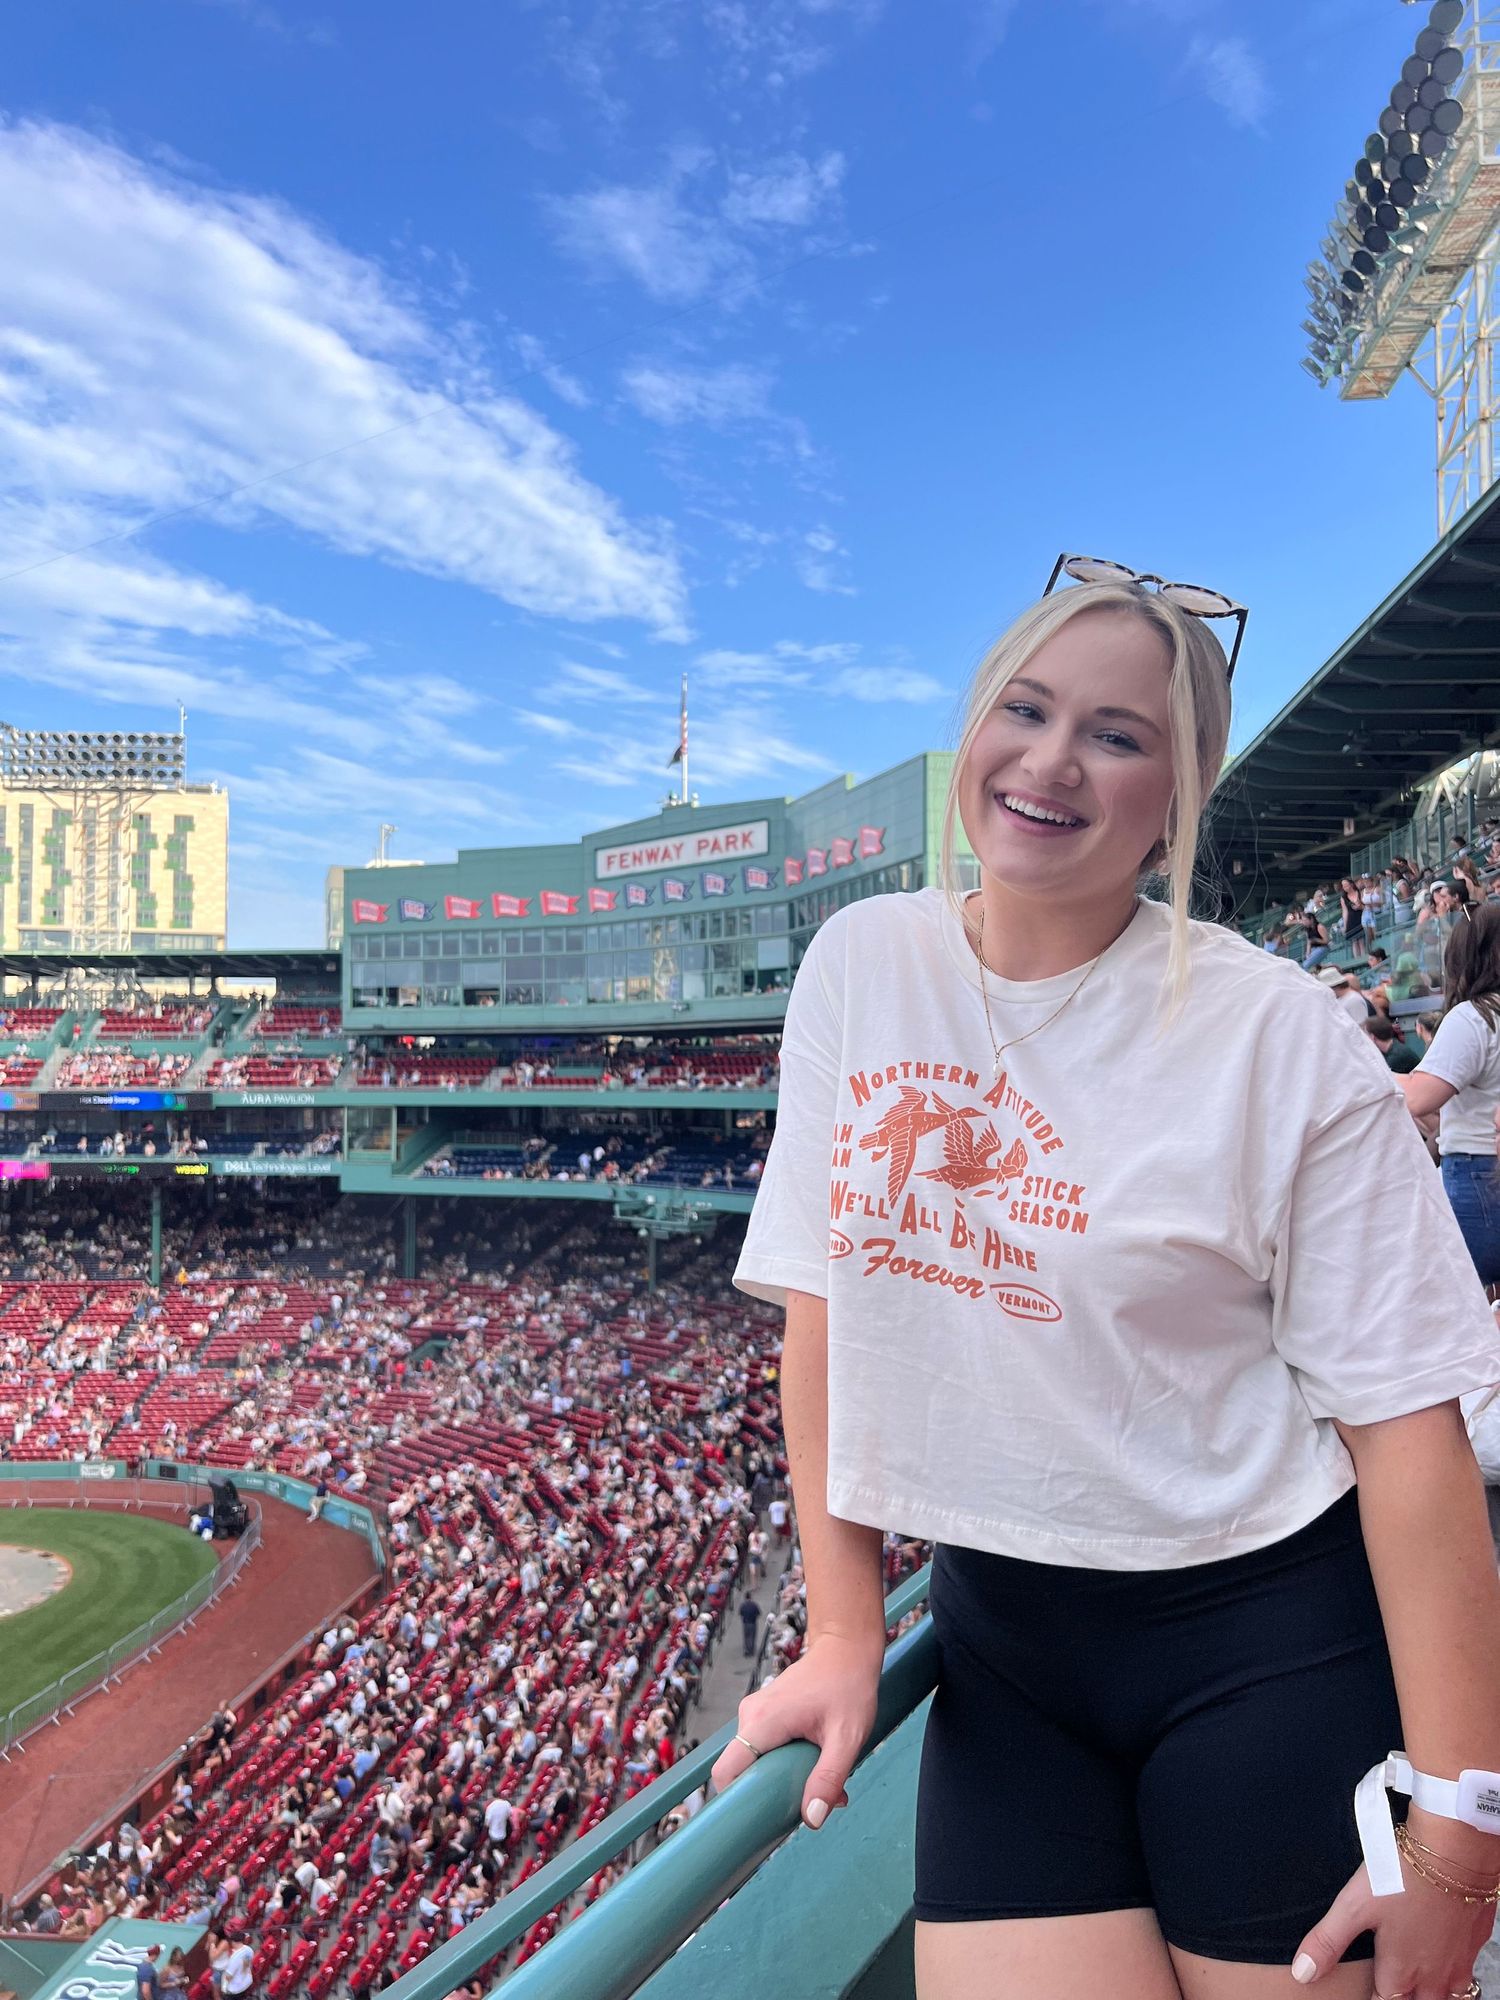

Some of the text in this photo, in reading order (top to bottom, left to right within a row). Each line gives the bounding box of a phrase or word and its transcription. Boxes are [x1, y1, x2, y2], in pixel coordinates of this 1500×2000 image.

[606, 831, 755, 872] FENWAY PARK
[274, 1093, 315, 1105] PAVILION
[848, 1061, 980, 1108] NORTHERN
[225, 1161, 332, 1174] DELL Technologies Level
[1021, 1175, 1086, 1206] STICK
[899, 1193, 942, 1235] ALL
[950, 1209, 976, 1251] BE
[982, 1227, 1038, 1273] HERE
[1008, 1200, 1089, 1234] SEASON
[861, 1238, 985, 1299] Forever
[998, 1291, 1051, 1315] VERMONT
